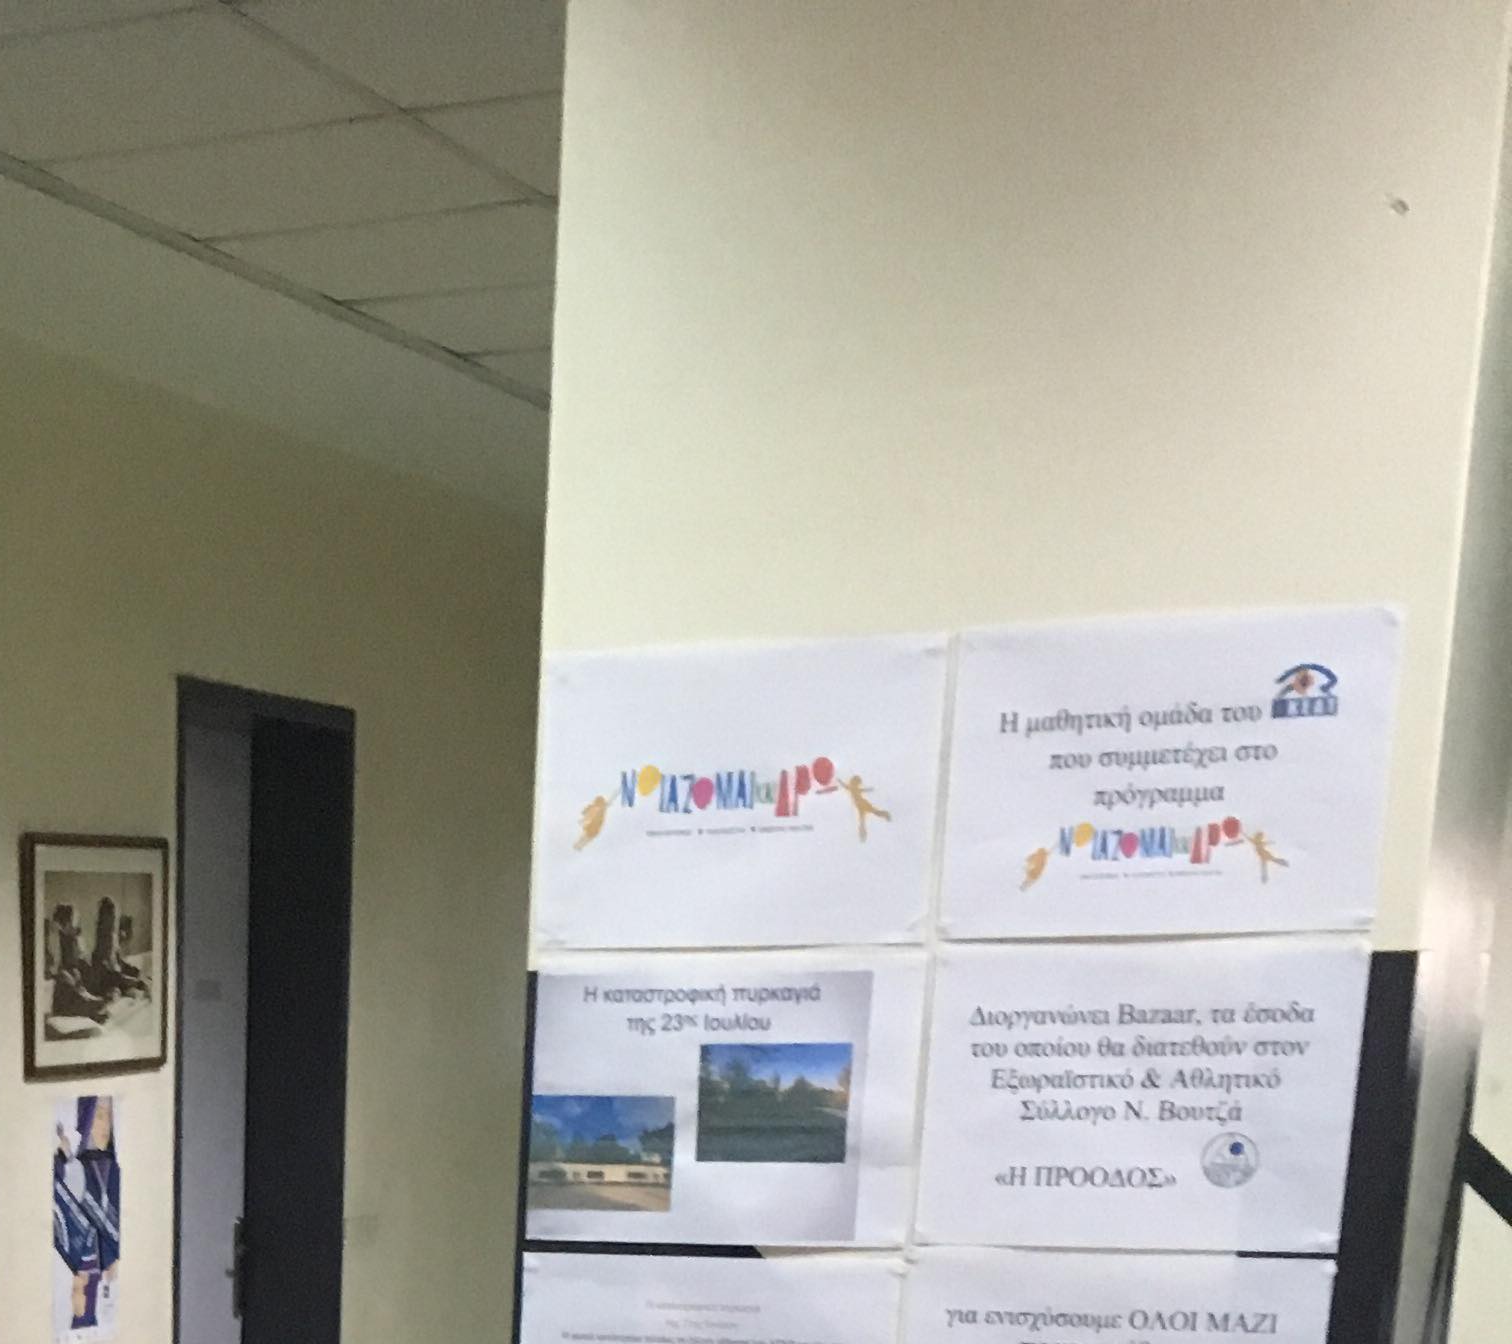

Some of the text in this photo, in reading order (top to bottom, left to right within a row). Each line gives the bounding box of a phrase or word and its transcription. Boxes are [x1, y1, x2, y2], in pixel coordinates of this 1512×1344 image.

[1000, 712, 1018, 733] Η
[1026, 706, 1131, 738] μαθητική
[1138, 702, 1212, 731] ομάδα
[1220, 704, 1262, 723] του
[1049, 740, 1278, 771] που συμμετέχει στο
[1093, 784, 1224, 811] πρόγραμμα
[584, 983, 821, 1006] Η καταστροφική πυρκαγιά
[627, 1016, 656, 1035] της
[704, 1012, 772, 1031] Ιουλίου
[968, 1000, 1315, 1030] Διοργανώνει Bazaar, τα έσοδα
[970, 1034, 1310, 1058] του οποίου θα διατεθούν στον
[990, 1066, 1282, 1094] Εξωραϊστικό & Αθλητικό
[1020, 1099, 1117, 1126] Σύλλογο
[1158, 1099, 1243, 1127] Βουτζά
[994, 1166, 1177, 1188] «Η ΠΡΟΟΔΟΣ»
[945, 1307, 1278, 1334] για ενισχύσουμε ΟΛΟΙ ΜΑΖΙ
